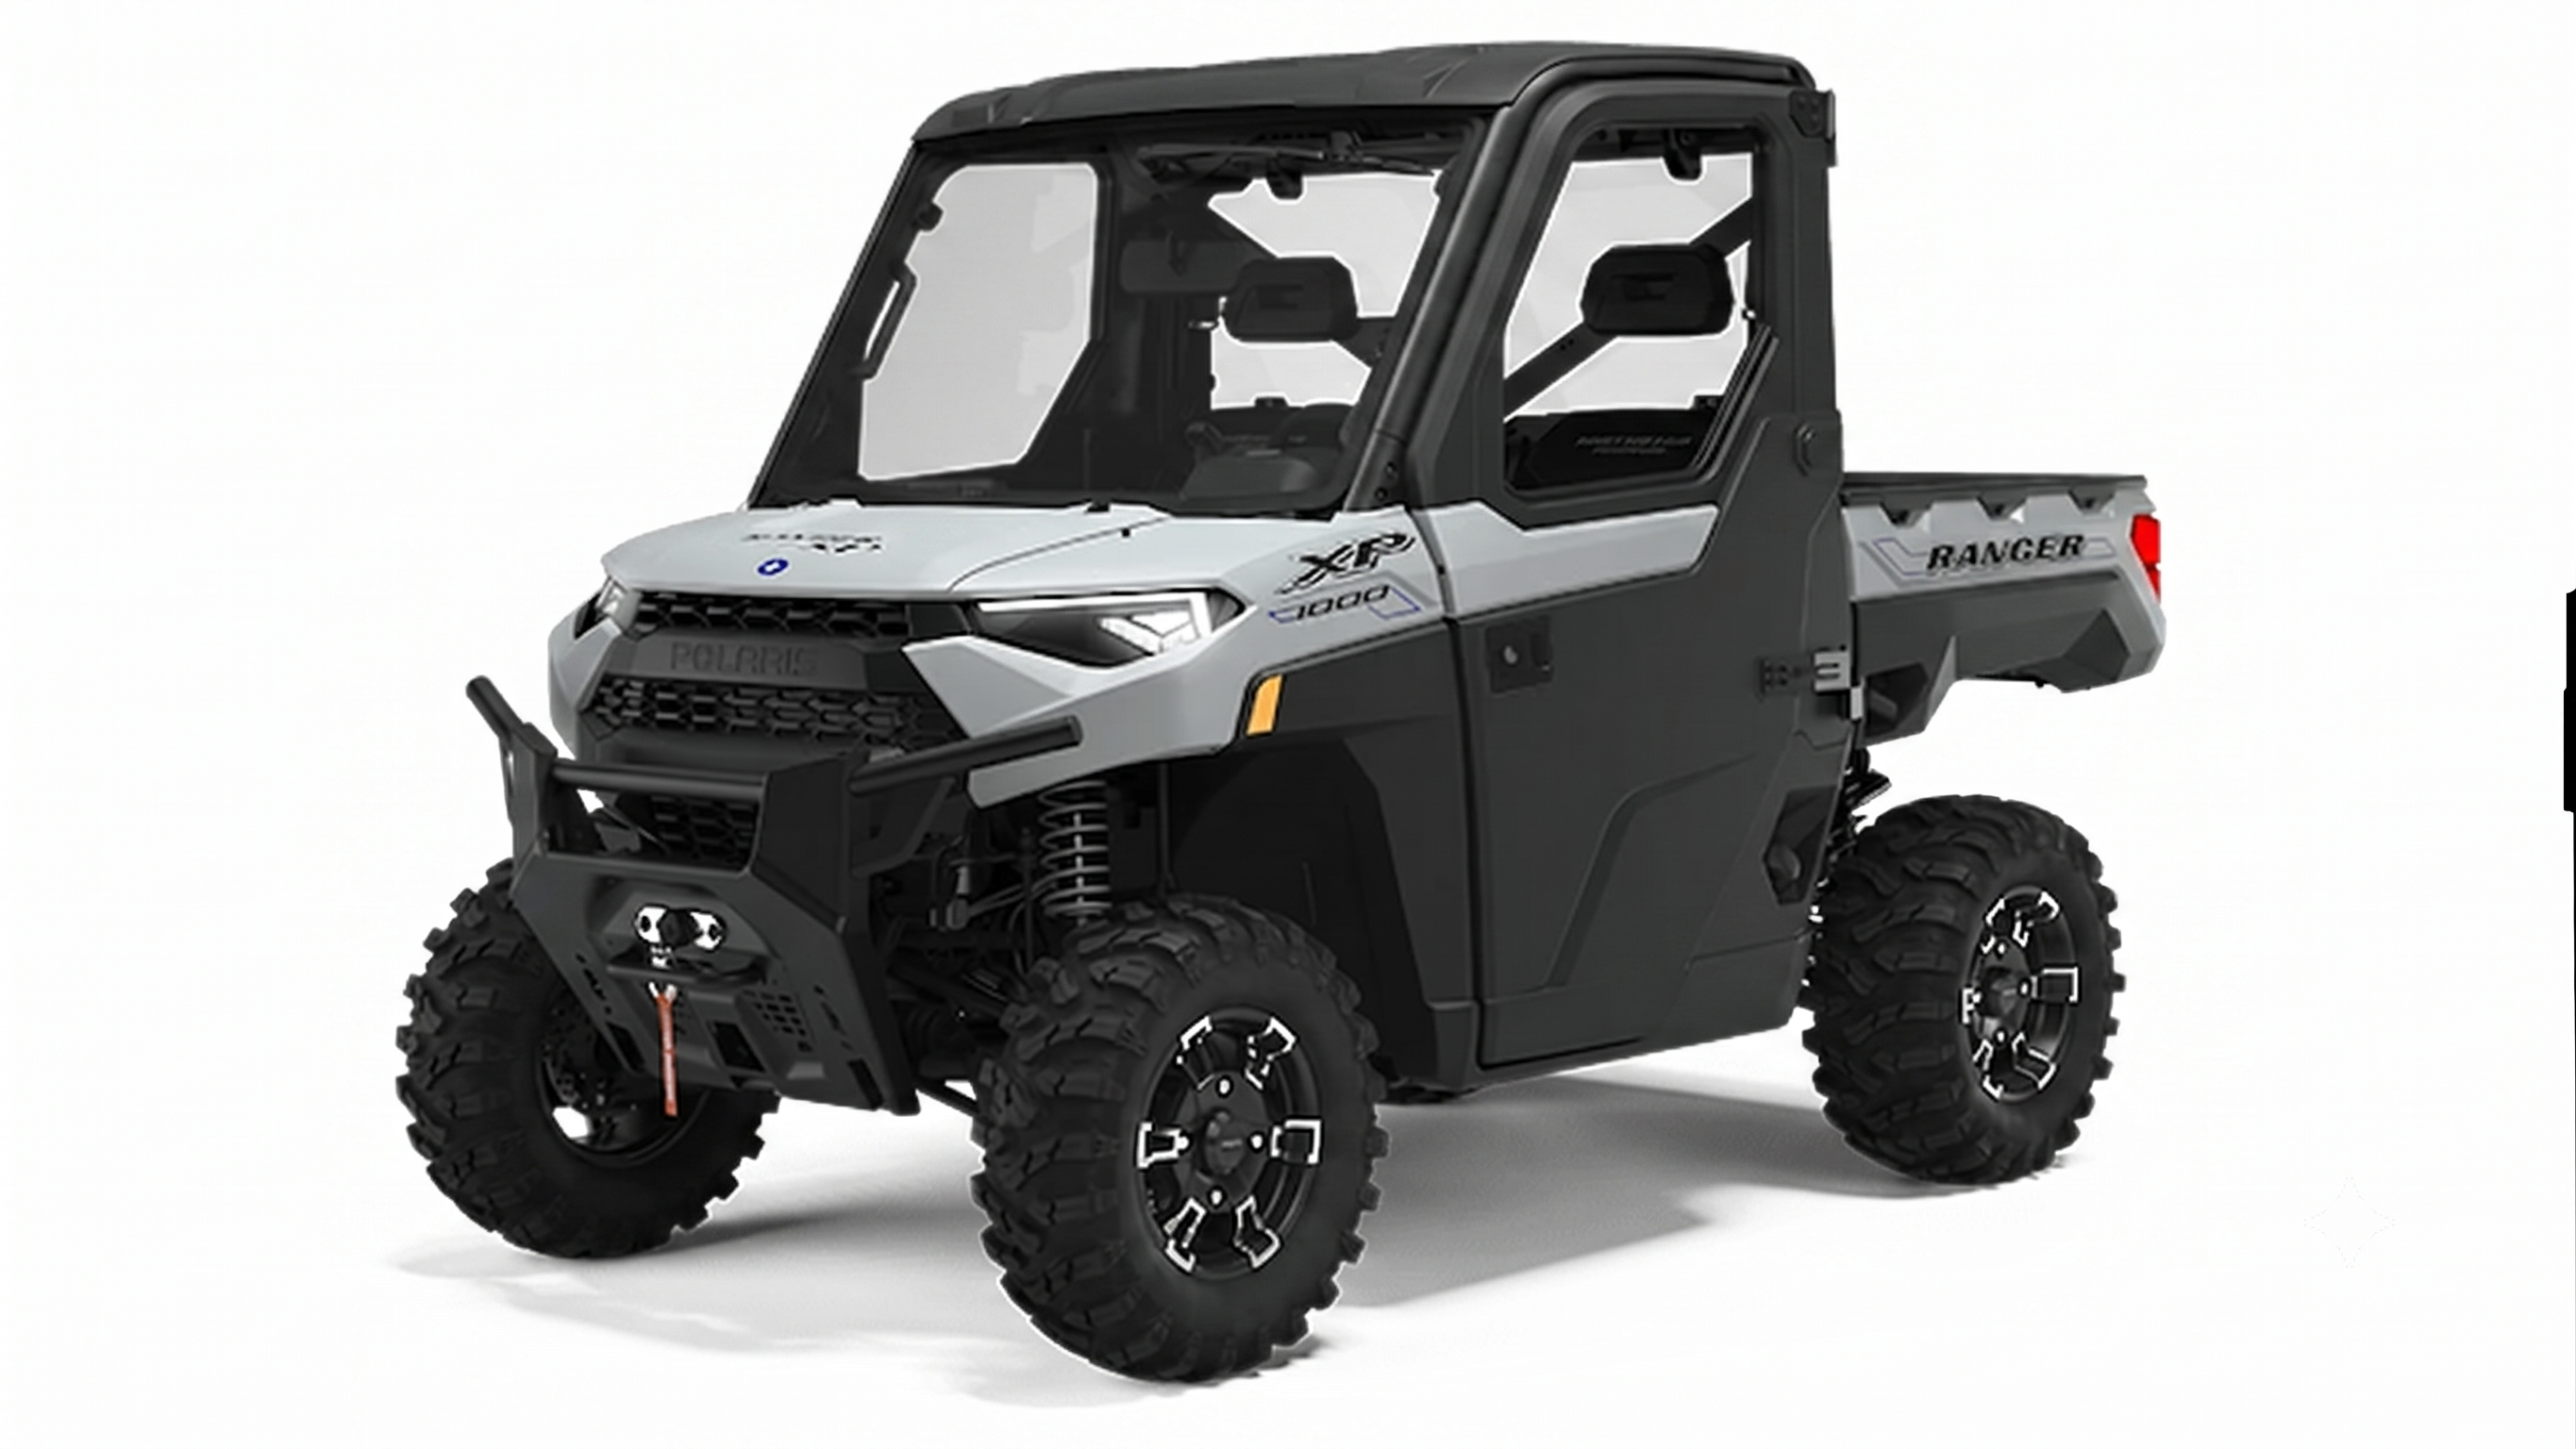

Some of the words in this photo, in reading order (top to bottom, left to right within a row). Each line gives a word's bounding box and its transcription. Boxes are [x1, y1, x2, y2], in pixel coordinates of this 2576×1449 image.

[1276, 532, 1416, 595] XP
[1926, 534, 2084, 572] RANGER
[1296, 585, 1390, 621] 1000
[671, 641, 818, 677] POLARIS
